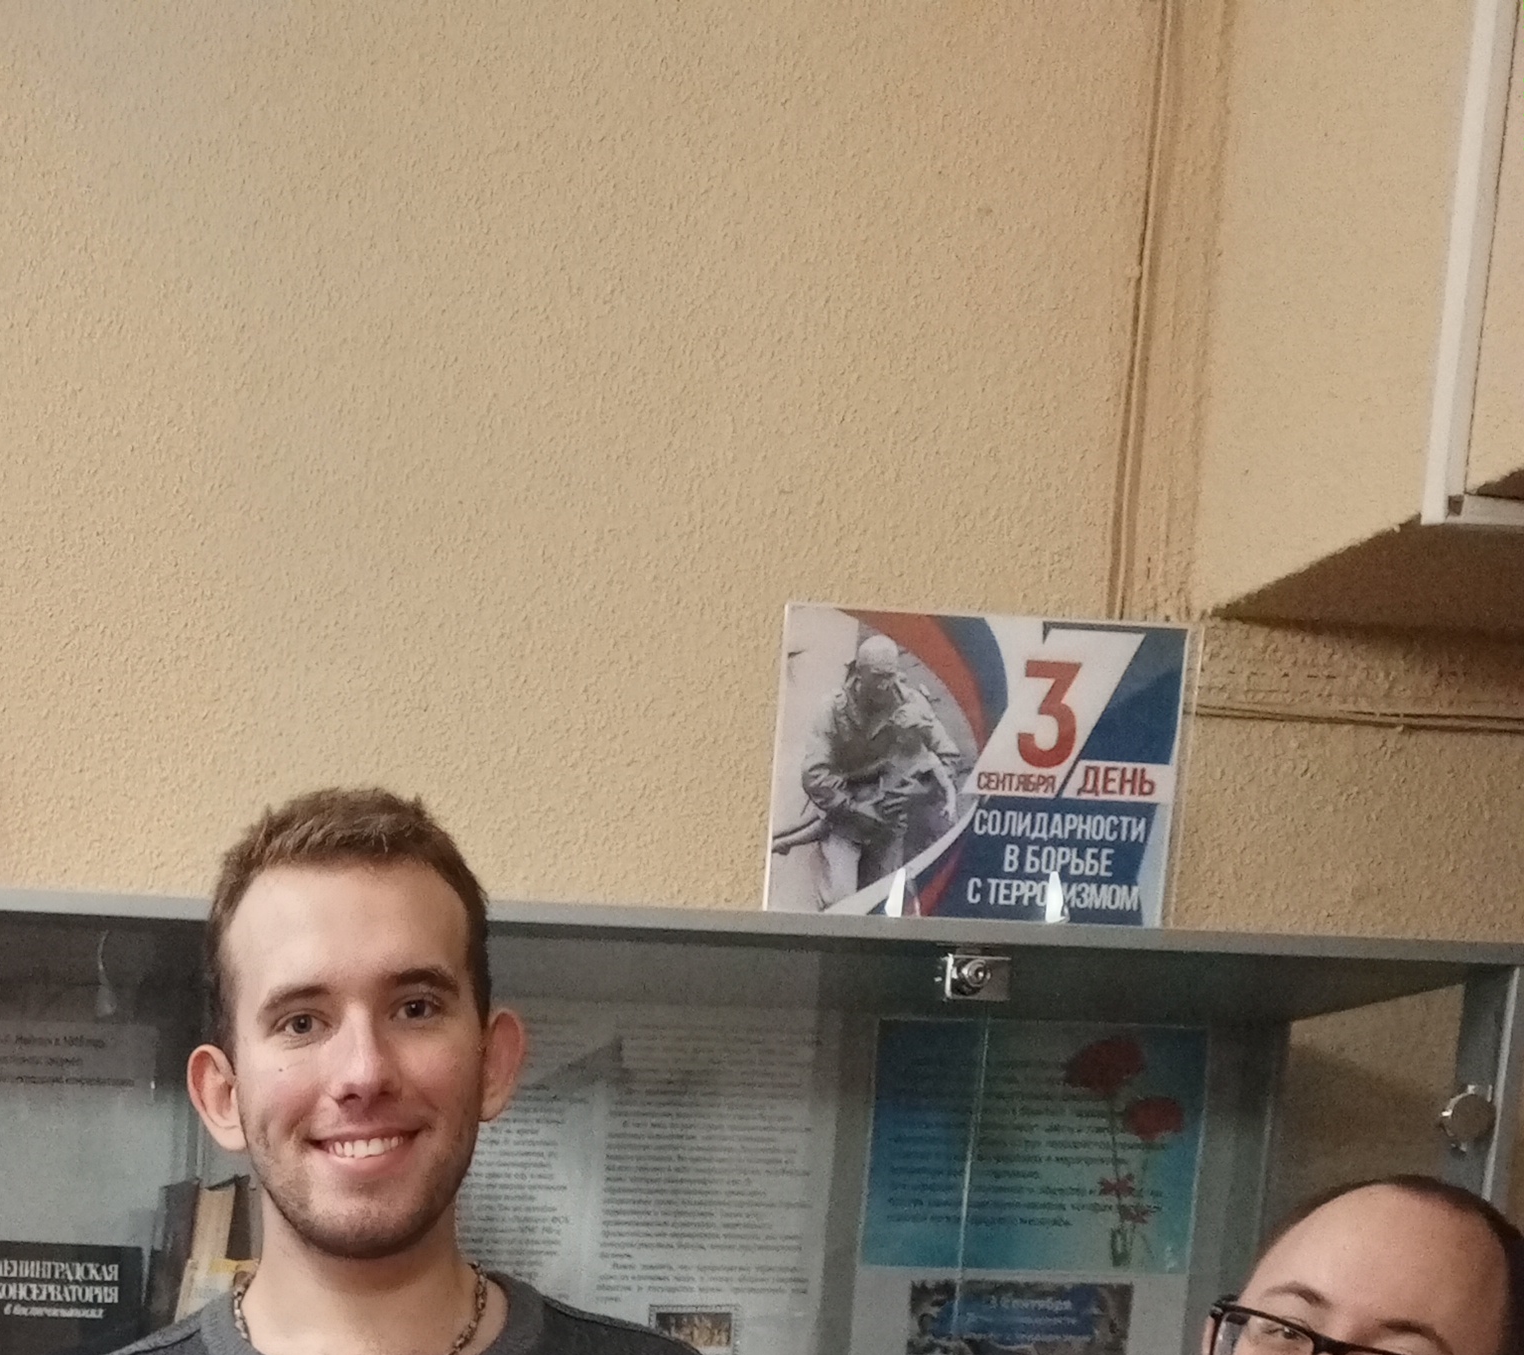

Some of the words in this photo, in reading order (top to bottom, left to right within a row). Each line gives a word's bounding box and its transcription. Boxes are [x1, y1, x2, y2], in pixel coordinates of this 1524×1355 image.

[1017, 659, 1083, 769] 3
[977, 772, 1057, 794] СЕНТЯБРЯ
[1077, 765, 1156, 797] ДЕНЬ
[975, 809, 1147, 844] СОЛИДАРНОСТИ
[1003, 845, 1019, 873] В
[1025, 848, 1114, 878] БОРЬБЕ
[966, 877, 982, 904] С
[988, 879, 1140, 912] ТЕРРОИЗМОМ
